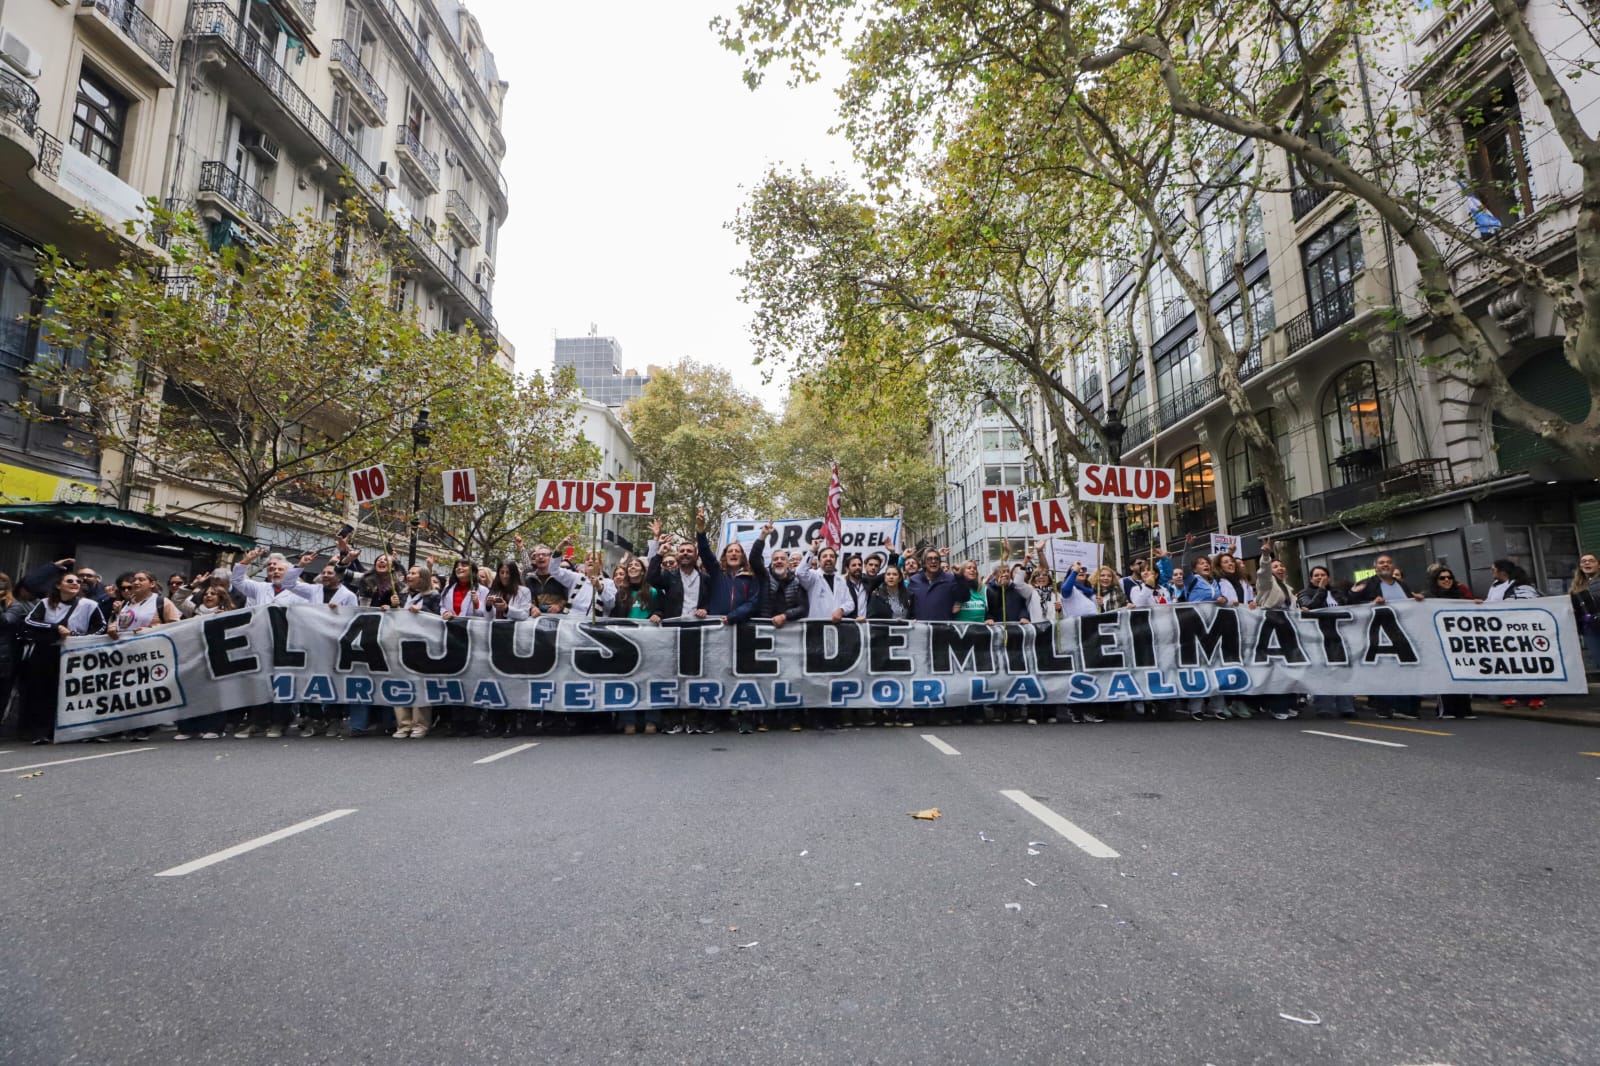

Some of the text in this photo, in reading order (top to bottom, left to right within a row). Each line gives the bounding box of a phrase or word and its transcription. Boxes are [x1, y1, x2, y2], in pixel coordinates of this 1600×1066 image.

[352, 467, 385, 501] NO
[452, 471, 476, 502] AL
[539, 481, 652, 513] AJUSTE
[1084, 465, 1172, 498] SALUD
[982, 490, 1017, 522] EN
[1032, 500, 1070, 535] LA
[842, 532, 866, 547] OR
[867, 532, 885, 547] EL
[1443, 616, 1546, 632] FORO POR EL
[204, 606, 1420, 678] EL AJUSTE DE MILEI MATA
[66, 650, 165, 674] FORO POR EL
[1455, 656, 1555, 675] A LA SALUD
[65, 686, 172, 715] A LA SALUD
[528, 678, 802, 710] FEDERAL
[829, 678, 946, 706] POR
[970, 674, 1045, 702] LA
[1068, 666, 1251, 700] SALUD
